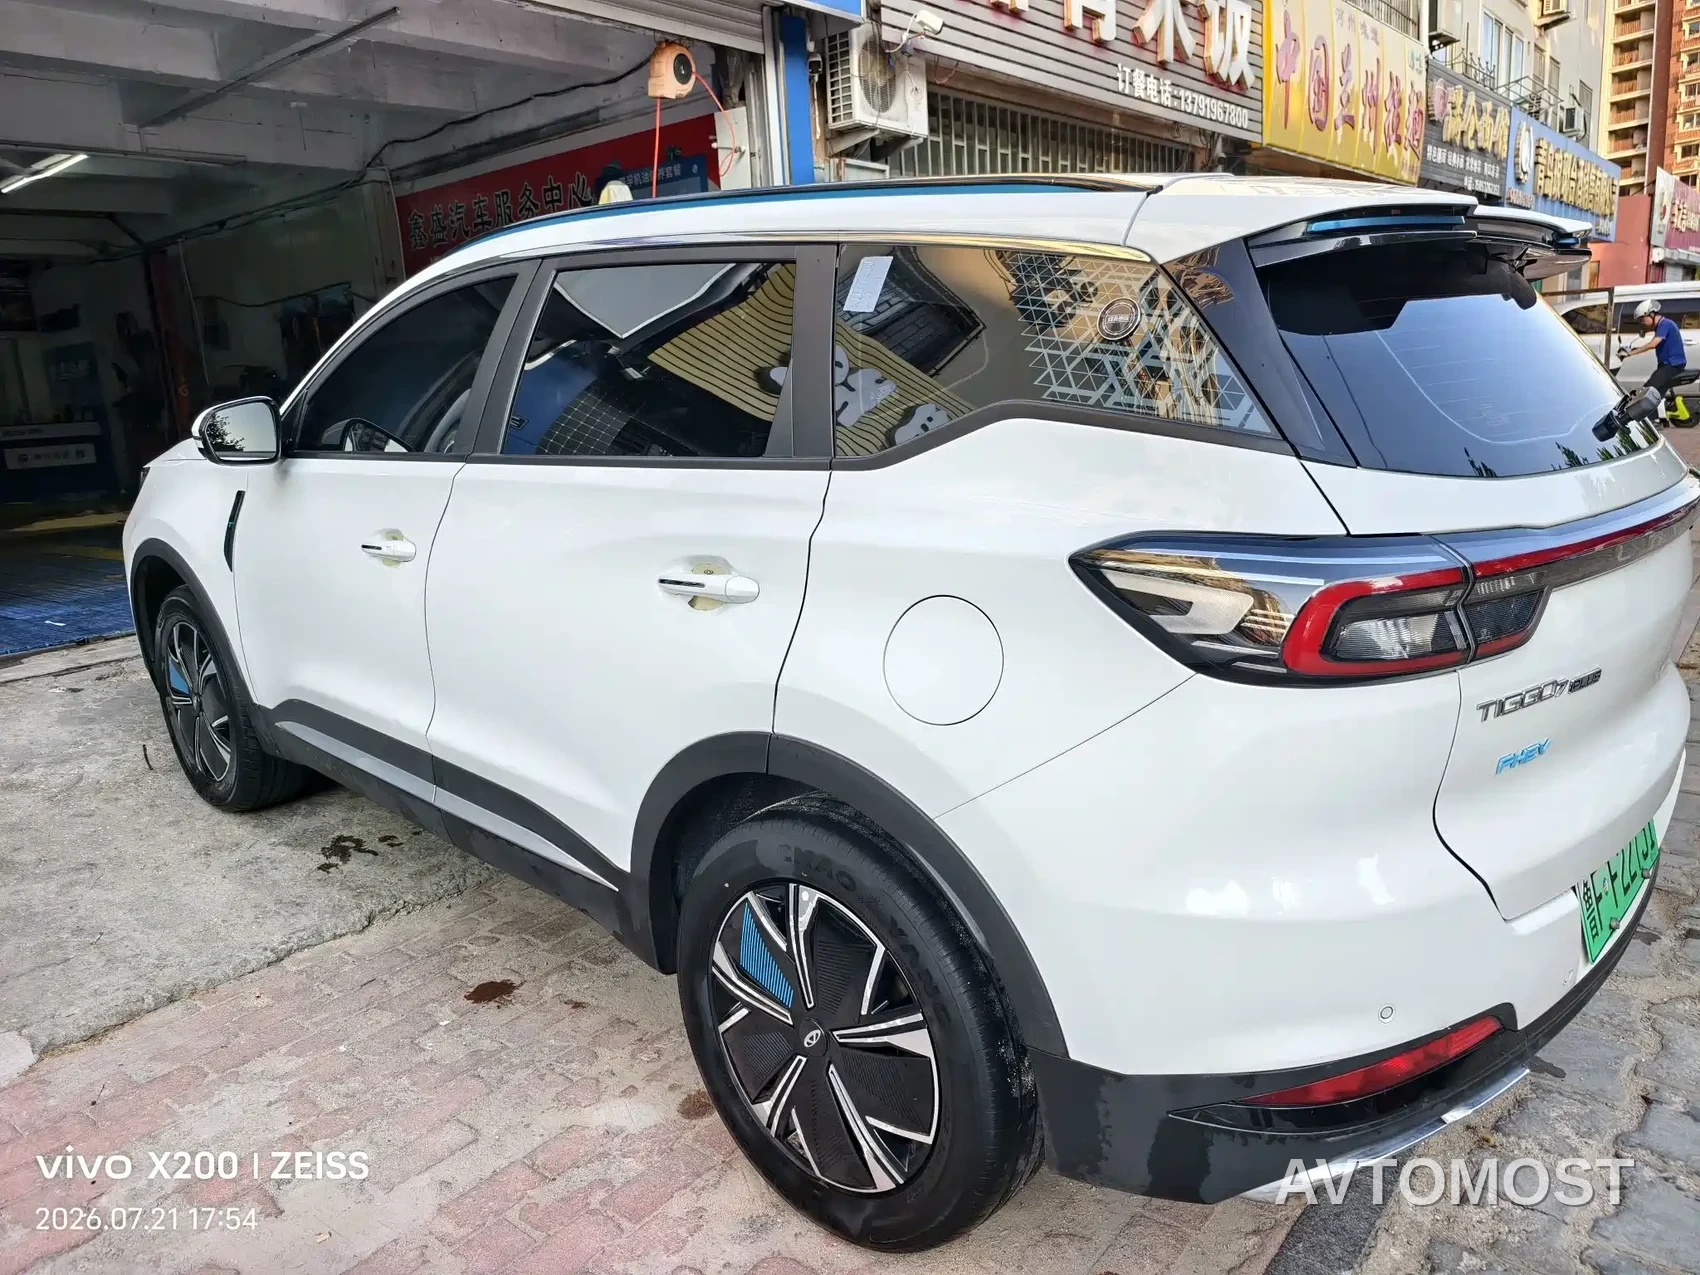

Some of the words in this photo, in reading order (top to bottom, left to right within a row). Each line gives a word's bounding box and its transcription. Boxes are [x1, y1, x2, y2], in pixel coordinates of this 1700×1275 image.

[1117, 63, 1249, 129] 订餐电话:13791967800
[408, 172, 594, 250] 鑫盛汽车服务中心
[1495, 738, 1554, 776] PHEV
